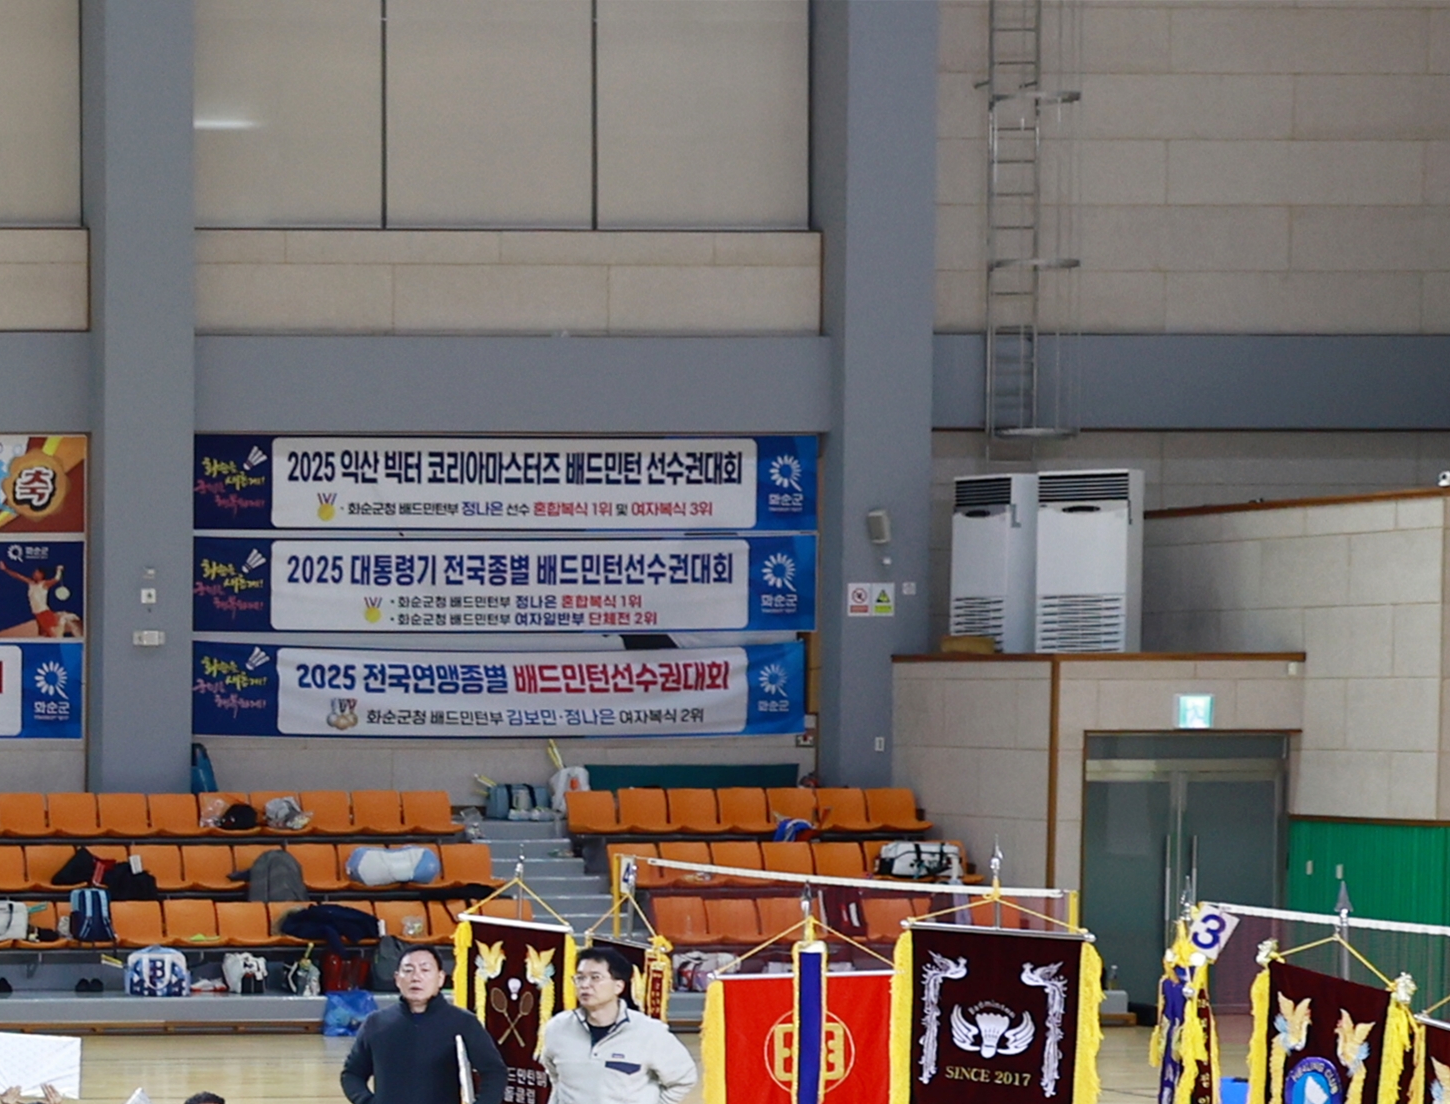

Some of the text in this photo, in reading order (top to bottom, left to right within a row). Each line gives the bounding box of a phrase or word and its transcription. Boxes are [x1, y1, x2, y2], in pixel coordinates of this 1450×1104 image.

[288, 450, 742, 485] 2025 익산 빅터 코리아마스터즈 배드민턴 선수권대회
[14, 467, 56, 508] 축
[348, 502, 713, 516] 화순군청 배드민턴부 정나은 선수 혼합복식 1위 및 여자복식 3위
[288, 553, 733, 586] 2025 대통령기 전국종별 배드민턴선수권대회
[398, 595, 642, 609] 화순군청 배드민턴부 정나은 혼합복식 1위
[398, 612, 657, 627] 화순군청 배드민턴부 여자일반부 단체전 2위
[296, 661, 729, 694] 2025 전국연맹종별 배드민턴선수권대회
[366, 710, 426, 725] 화순군청
[430, 709, 503, 725] 배드민턴부
[619, 709, 677, 725] 여자복식
[681, 708, 704, 723] 2위
[1191, 913, 1227, 950] 3
[945, 1065, 1032, 1087] SINCE 2017
